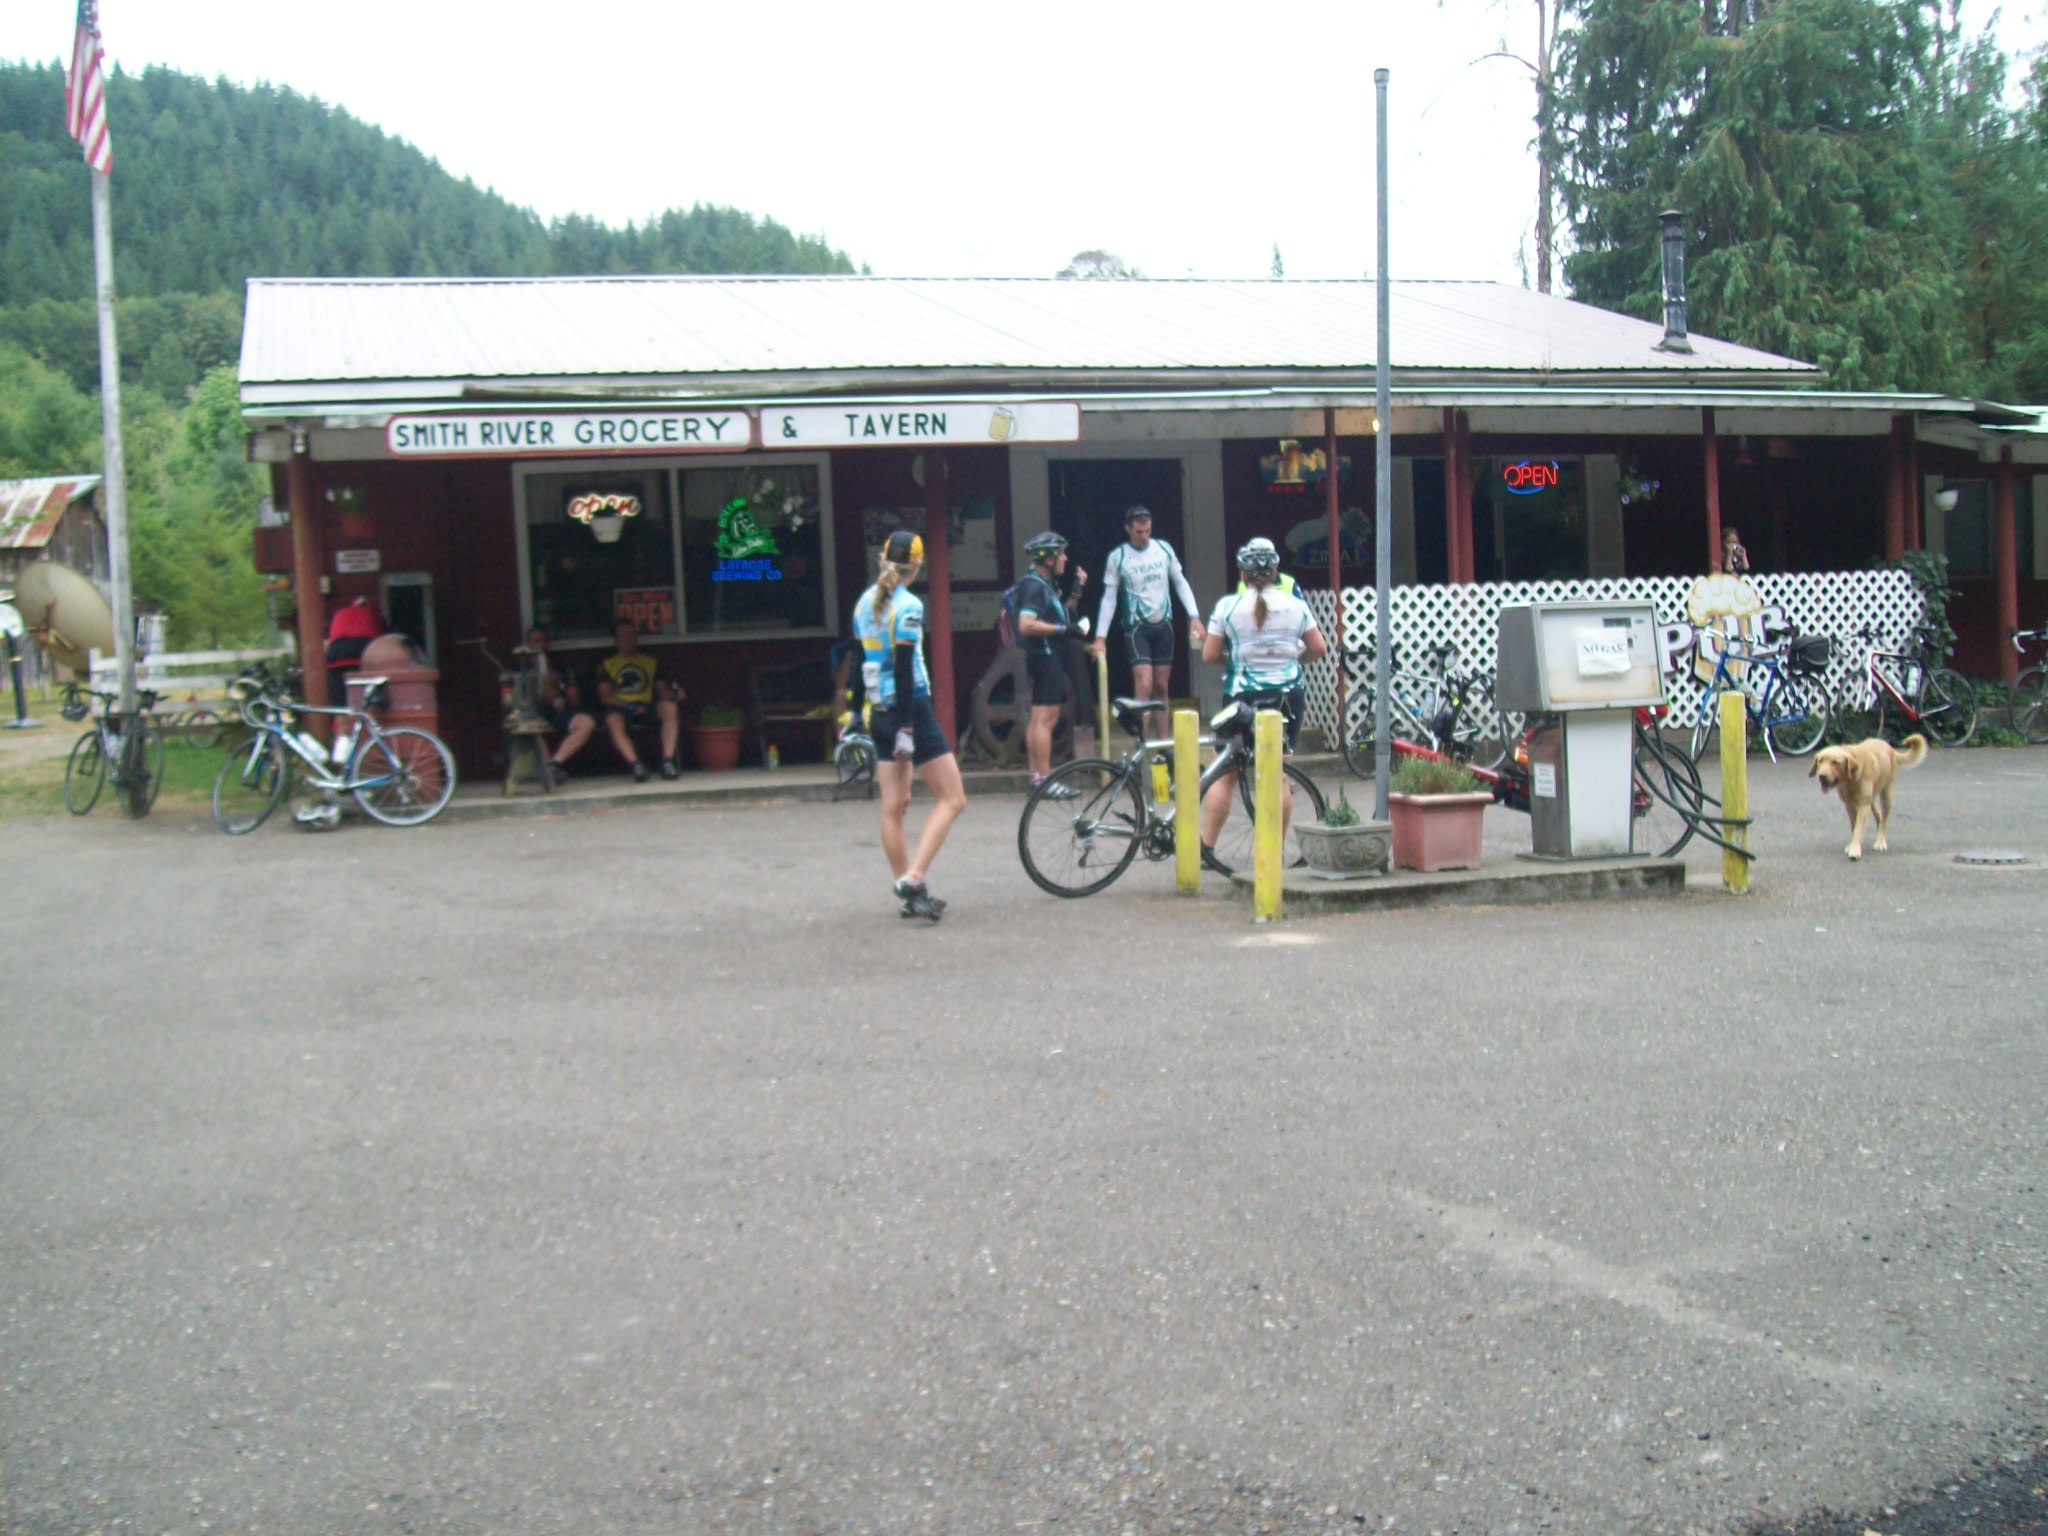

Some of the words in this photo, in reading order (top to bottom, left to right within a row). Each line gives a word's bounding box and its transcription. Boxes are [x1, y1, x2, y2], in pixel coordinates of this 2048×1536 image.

[396, 423, 468, 448] SMITH
[479, 420, 555, 446] RIVER
[574, 417, 731, 444] GROCERY
[781, 415, 798, 438] &
[844, 412, 948, 438] TAVERN
[1503, 464, 1557, 487] OPEN
[1582, 643, 1599, 654] NO
[1601, 643, 1624, 653] GAS
[1657, 605, 1797, 678] PUB
